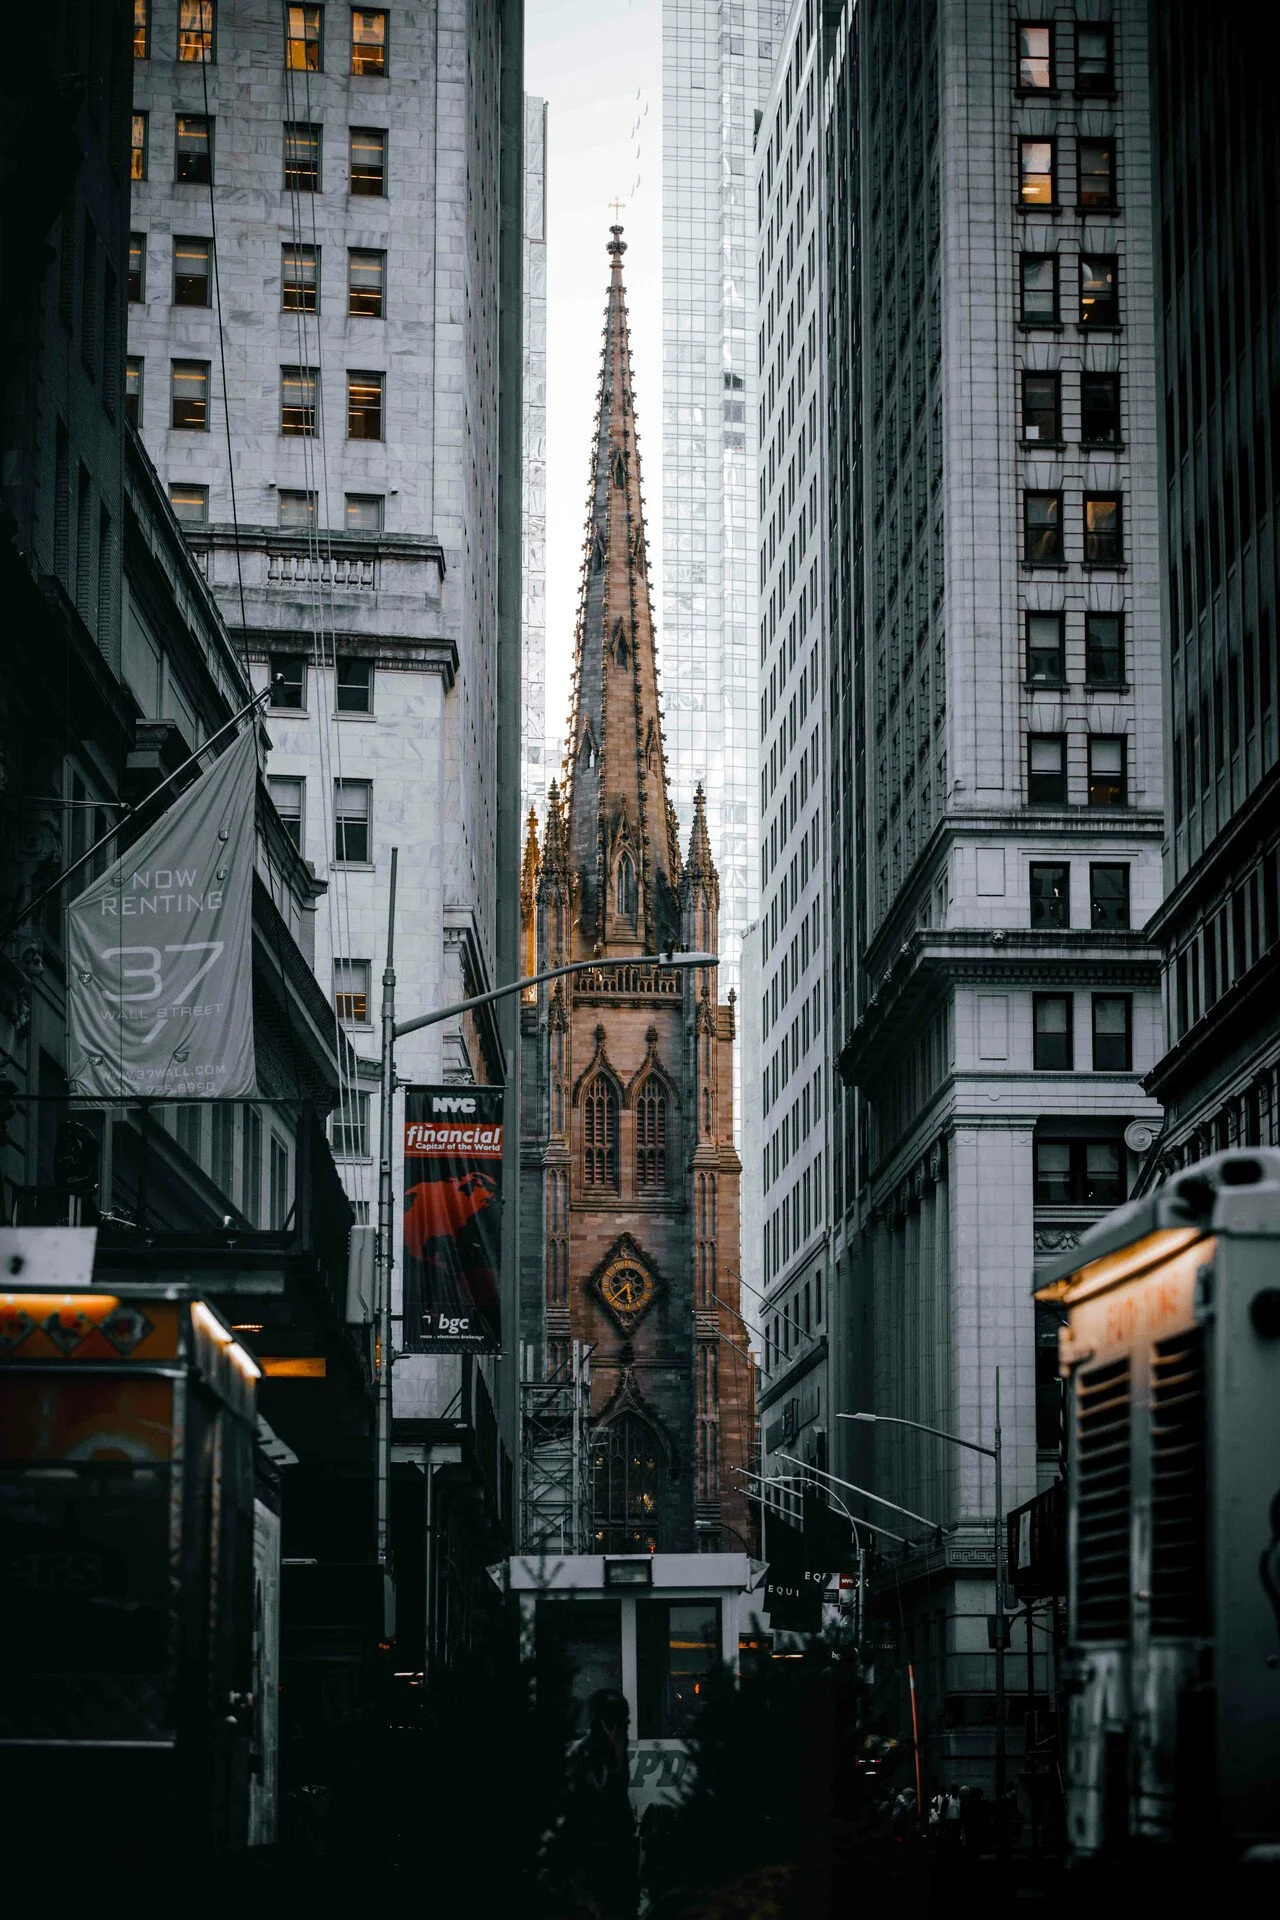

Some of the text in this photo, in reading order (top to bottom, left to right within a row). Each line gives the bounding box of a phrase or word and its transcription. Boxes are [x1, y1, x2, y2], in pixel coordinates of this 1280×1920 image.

[132, 869, 197, 889] NOW
[101, 891, 223, 915] RENTING
[101, 941, 224, 1043] 37
[101, 1003, 224, 1020] WALL STREET
[432, 1097, 476, 1113] NYC
[407, 1125, 501, 1147] financial
[416, 1142, 501, 1152] Capital of the World
[439, 1313, 469, 1334] bgc
[768, 1585, 799, 1598] EQUI
